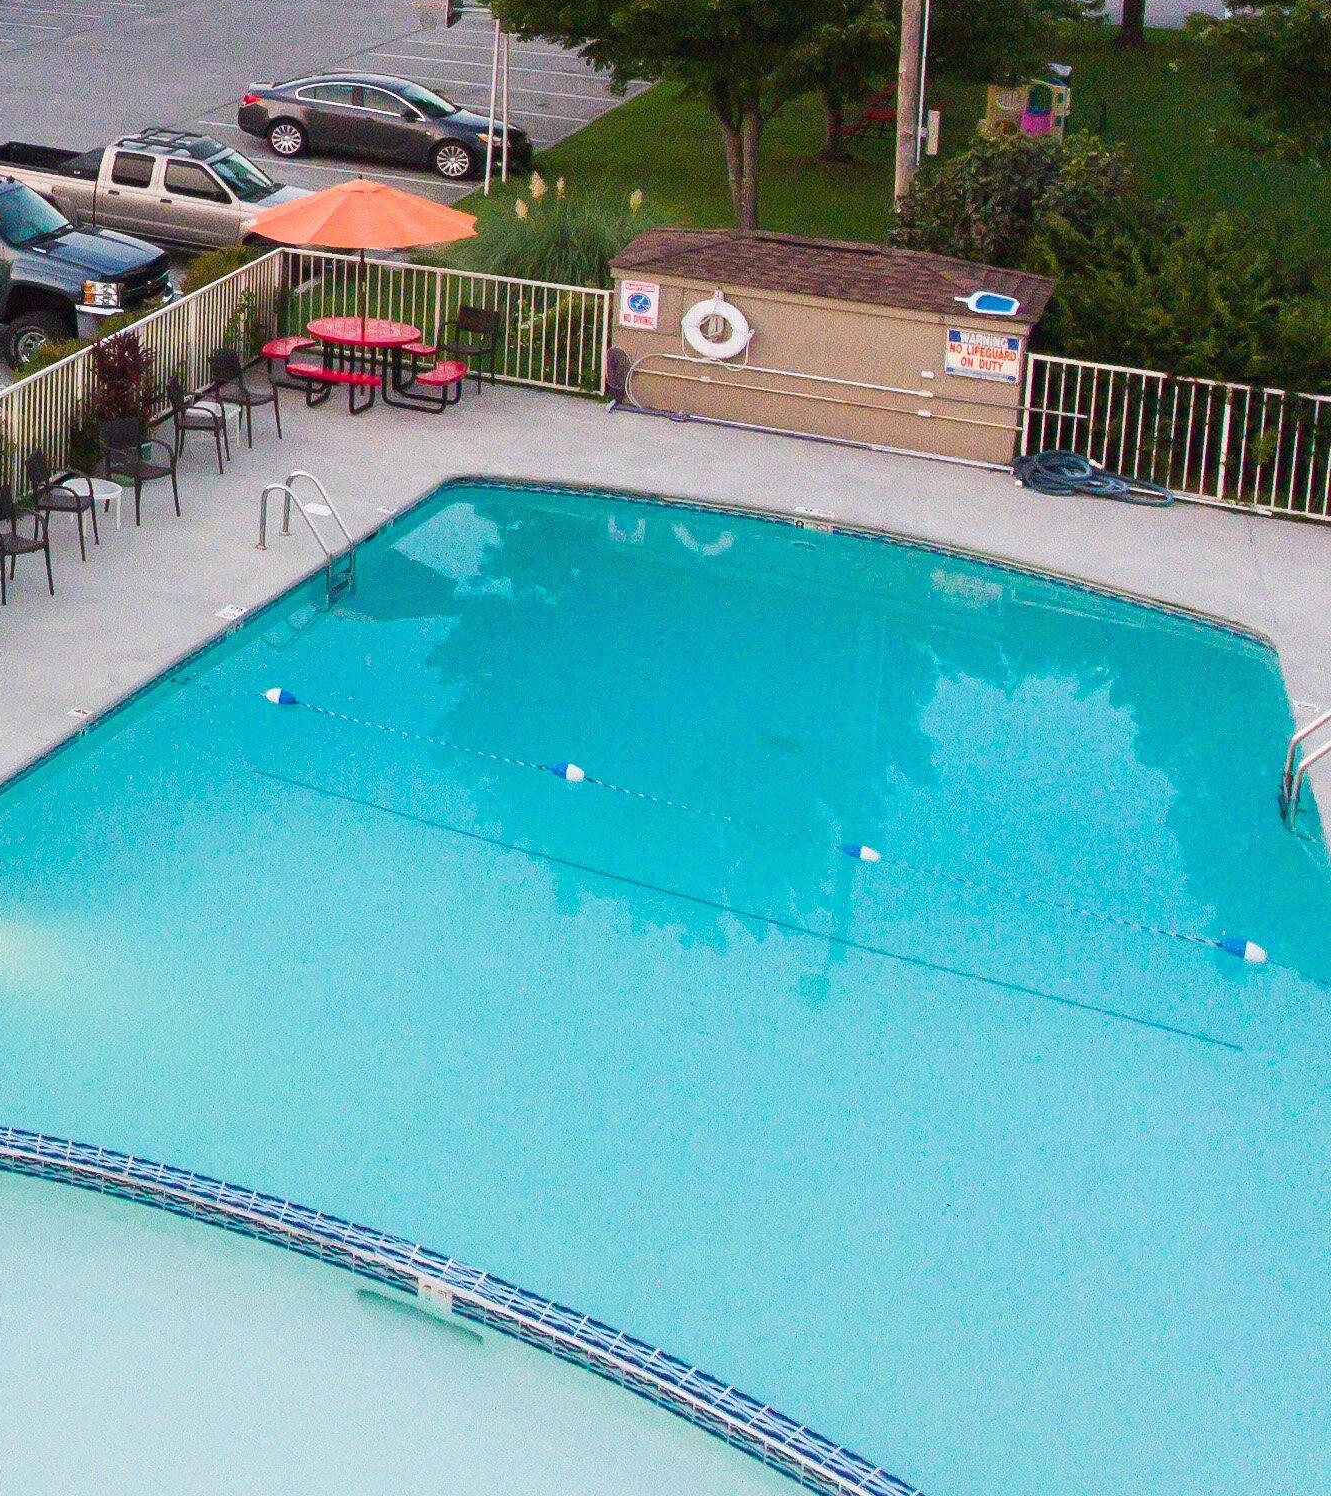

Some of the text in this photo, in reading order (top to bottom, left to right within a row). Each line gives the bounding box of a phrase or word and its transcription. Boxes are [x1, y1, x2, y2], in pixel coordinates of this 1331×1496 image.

[949, 342, 1017, 362] NO LIFEGUARD
[960, 356, 1004, 372] ON DUTY
